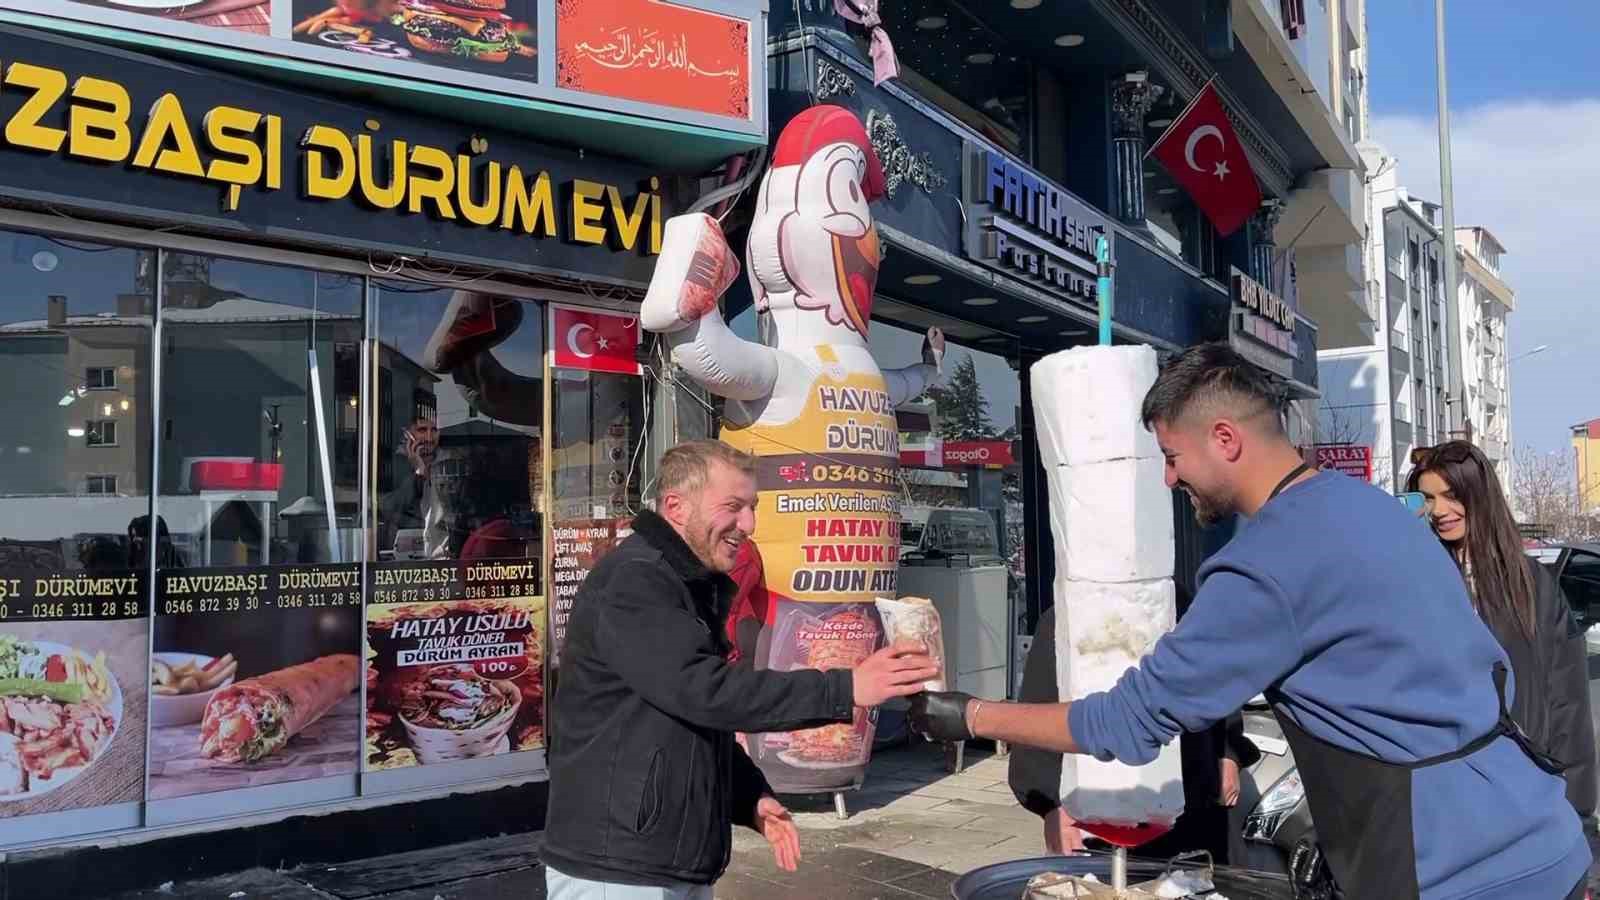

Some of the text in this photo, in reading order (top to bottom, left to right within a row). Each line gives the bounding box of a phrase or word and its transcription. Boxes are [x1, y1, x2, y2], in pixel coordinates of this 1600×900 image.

[5, 61, 281, 211] ZBAŞI
[573, 175, 663, 256] EVİ
[1318, 448, 1366, 461] SARAY
[812, 465, 870, 482] 0346
[777, 494, 825, 513] Emek
[827, 493, 879, 512] Verilen
[585, 528, 609, 539] AYRAN
[807, 519, 883, 537] HATAY
[801, 544, 884, 562] TAVUK
[554, 557, 578, 569] ZURNA
[166, 566, 360, 596] HAVUZBAŞI DÜRÜMEVİ
[374, 561, 534, 586] HAVUZBAŞI DÜRÜMEVİ
[554, 570, 575, 582] MEGA
[792, 570, 867, 592] ODUN
[35, 573, 138, 597] DÜRÜMEVİ
[374, 591, 396, 604] 0546
[402, 590, 418, 602] 872
[424, 589, 434, 601] 39
[440, 588, 450, 600] 30
[466, 587, 486, 599] 0346
[491, 585, 505, 597] 311
[511, 585, 520, 596] 28
[525, 584, 534, 595] 58
[32, 603, 64, 618] 0346
[71, 603, 94, 617] 311
[101, 602, 116, 616] 28
[123, 601, 138, 616] 58
[165, 600, 193, 614] 0546
[199, 598, 220, 612] 872
[226, 598, 240, 611] 39
[245, 596, 259, 610] 30
[277, 594, 303, 608] 0346
[308, 593, 326, 607] 311
[331, 592, 344, 606] 28
[349, 592, 361, 605] 58
[391, 616, 463, 639] HATAY
[418, 635, 461, 651] TAVUK
[468, 644, 519, 659] AYRAN
